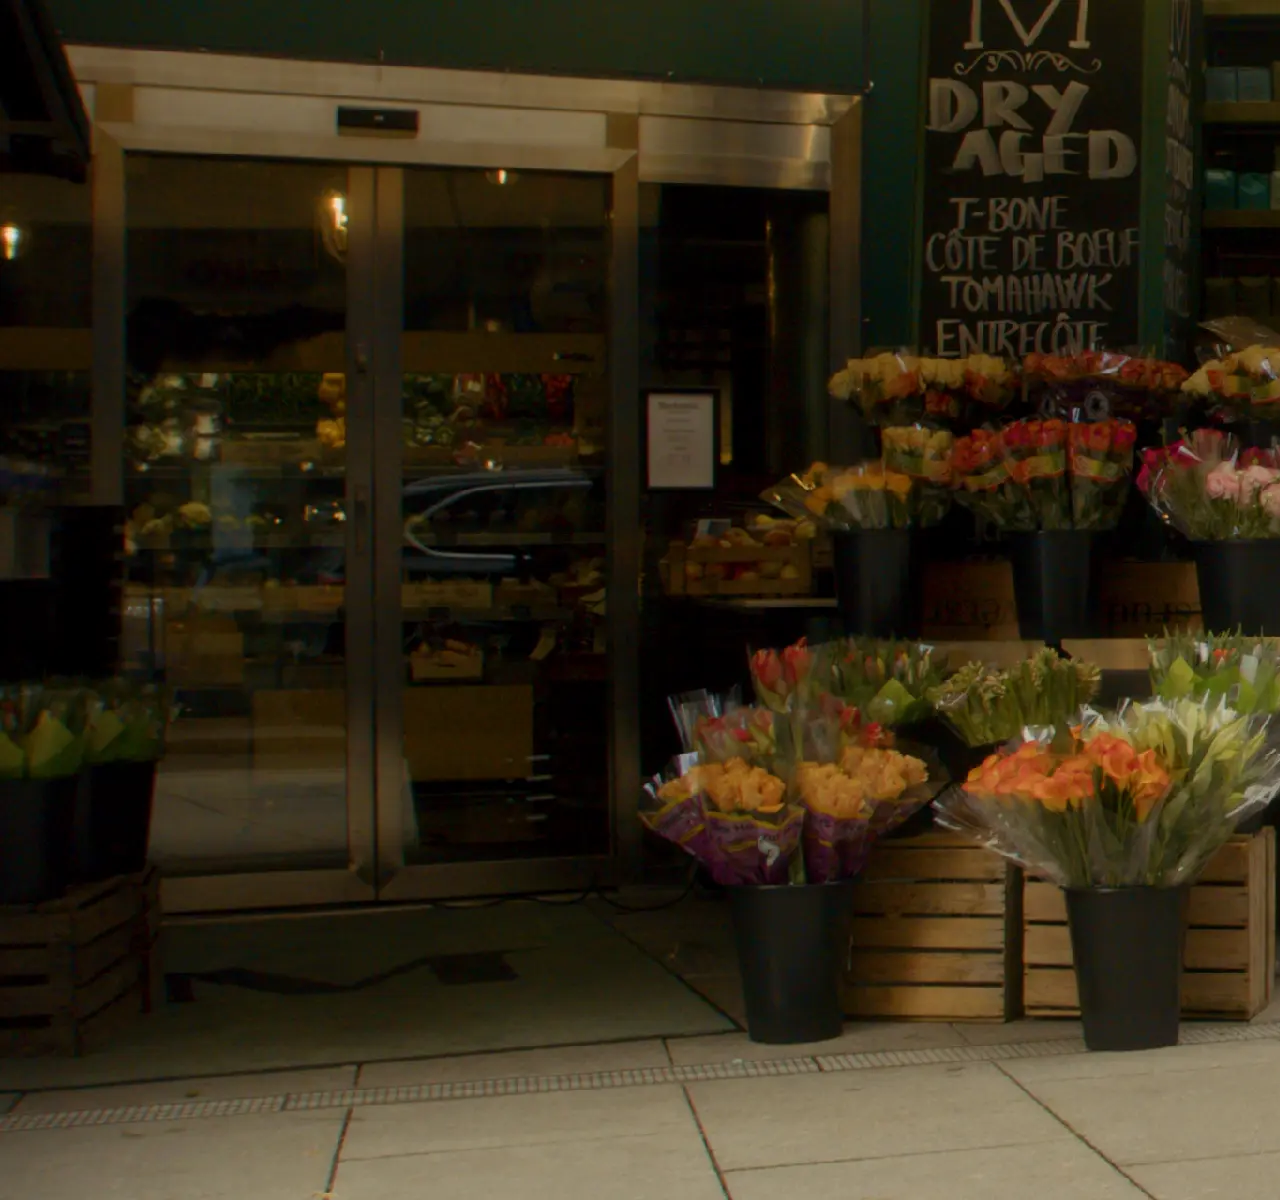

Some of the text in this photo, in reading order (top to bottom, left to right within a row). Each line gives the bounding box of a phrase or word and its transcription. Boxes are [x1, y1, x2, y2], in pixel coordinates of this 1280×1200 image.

[925, 77, 1090, 137] DRY
[951, 128, 1138, 183] AGED
[949, 195, 1070, 234] T-BONE
[925, 227, 1140, 273] CÔTE DE BOEUF
[940, 272, 1113, 315] TOMAHAWK
[935, 312, 1108, 358] ENTRECÔTE
